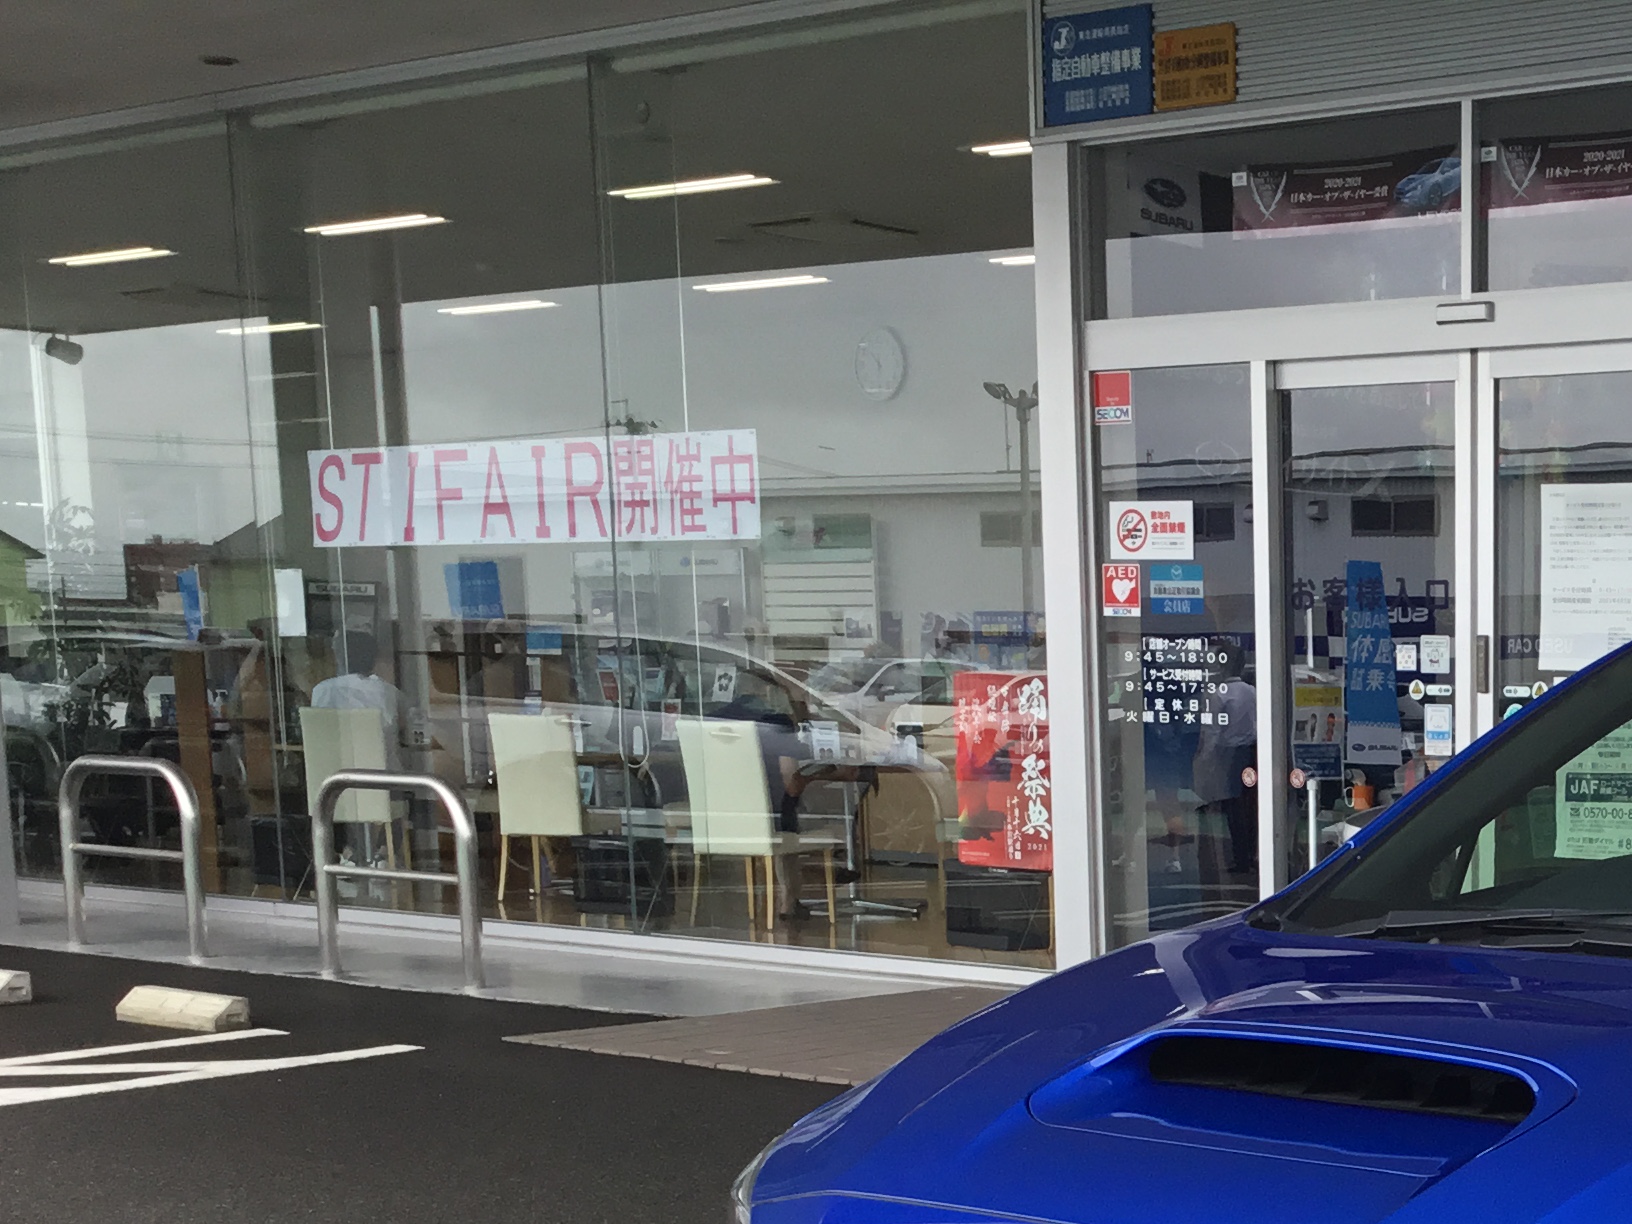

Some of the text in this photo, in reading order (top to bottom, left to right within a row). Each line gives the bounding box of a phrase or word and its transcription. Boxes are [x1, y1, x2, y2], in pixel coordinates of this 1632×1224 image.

[1139, 206, 1194, 232] SUBARU
[1096, 407, 1130, 420] SECOM
[1150, 521, 1186, 534] 全面禁煙
[1106, 566, 1137, 578] AED
[1291, 577, 1450, 611] お客様入口
[1126, 710, 1229, 725] 火曜日・水曜日
[1570, 779, 1600, 795] JAF
